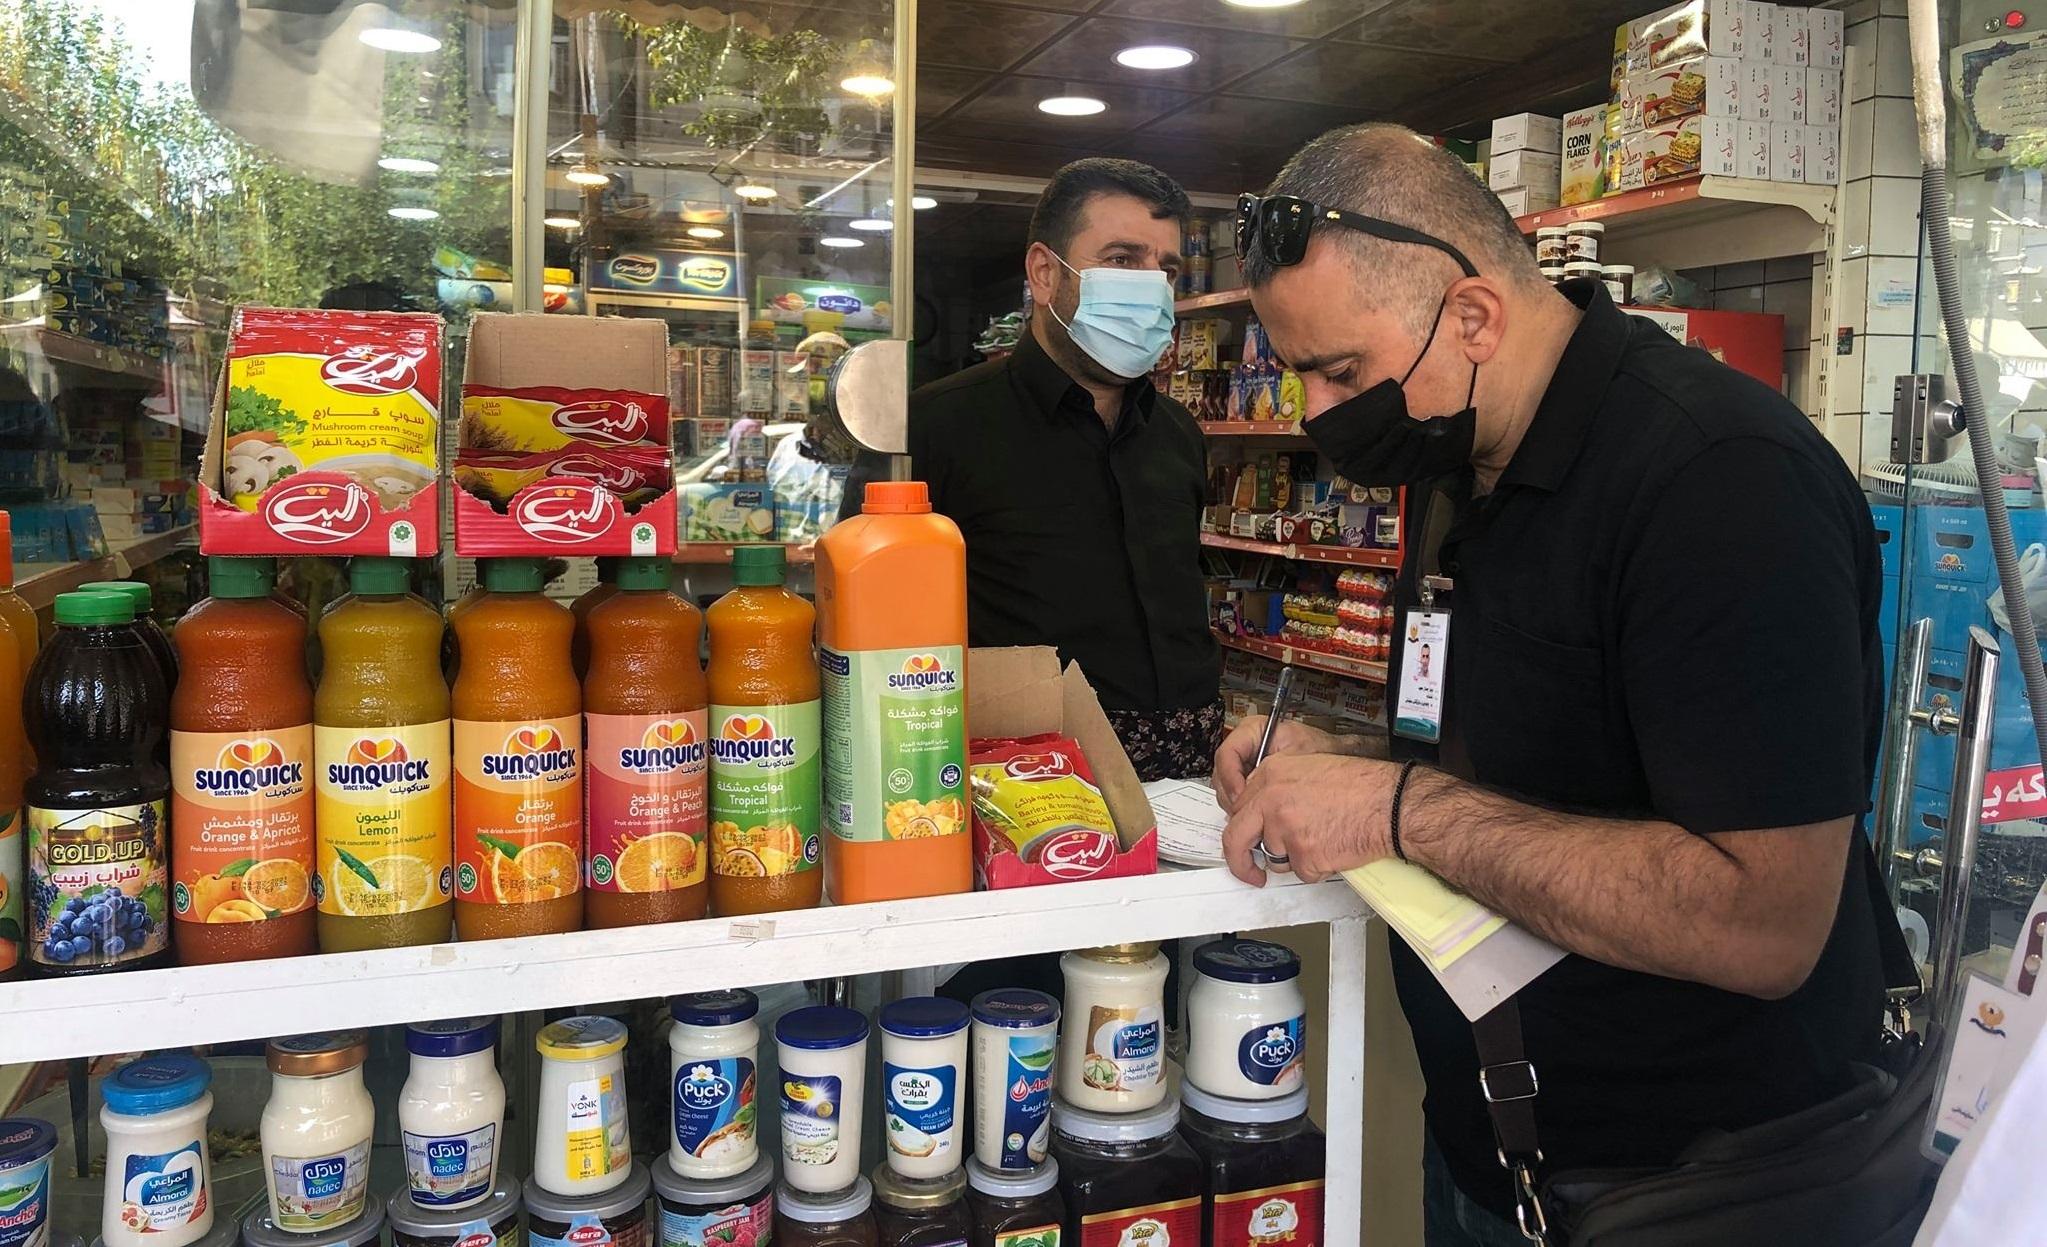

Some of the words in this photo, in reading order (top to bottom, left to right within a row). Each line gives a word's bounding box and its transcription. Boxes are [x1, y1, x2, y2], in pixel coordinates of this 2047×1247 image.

[1566, 113, 1595, 128] Kellogg's
[1567, 133, 1592, 150] CORN
[1566, 146, 1590, 160] FLAKES
[312, 422, 366, 432] Mushroom
[369, 424, 401, 433] cream
[402, 428, 425, 441] soup
[345, 436, 378, 449] كريمة
[888, 669, 955, 688] SUNQUICK
[888, 706, 927, 719] مشكلة
[929, 705, 959, 718] فواكه
[905, 718, 943, 732] Tropical
[621, 741, 706, 769] SUNQUICK
[709, 737, 795, 761] SUNQUICK
[483, 749, 576, 777] SUNQUICK
[195, 762, 303, 792] SUNQUICK
[328, 758, 430, 787] SUNQUICK
[894, 775, 906, 785] 50
[717, 782, 751, 794] مشكلة
[753, 782, 784, 793] فواكه
[518, 799, 554, 812] برتقال
[630, 794, 660, 807] الخوخ
[729, 794, 768, 808] Tropical
[356, 809, 401, 824] الليمون
[630, 806, 669, 819] Orange
[672, 803, 680, 813] &
[682, 799, 703, 812] Peach
[1018, 805, 1047, 818] Barley
[203, 815, 264, 831] ومشمش
[267, 812, 299, 827] برتقال
[515, 811, 556, 825] Orange
[201, 831, 245, 845] Orange
[250, 830, 259, 840] &
[263, 824, 301, 842] Apricot
[359, 824, 398, 836] Lemon
[52, 871, 90, 888] زبيب
[96, 863, 140, 886] شراب
[1122, 1023, 1156, 1040] المراعي
[1122, 1043, 1156, 1057] Almarai
[1258, 1042, 1292, 1059] Puck
[1124, 1072, 1147, 1081] Cheddar
[684, 1082, 726, 1098] Puck
[570, 1100, 597, 1110] VONK
[694, 1097, 712, 1105] بوك
[432, 1161, 464, 1174] nadec
[149, 1170, 188, 1189] المراعي
[307, 1181, 341, 1195] nadec
[149, 1189, 189, 1204] Almarai
[0, 1201, 39, 1226] Anchor
[706, 1220, 738, 1236] RASPBERRY
[738, 1216, 751, 1226] JAM
[572, 1230, 602, 1242] Sera
